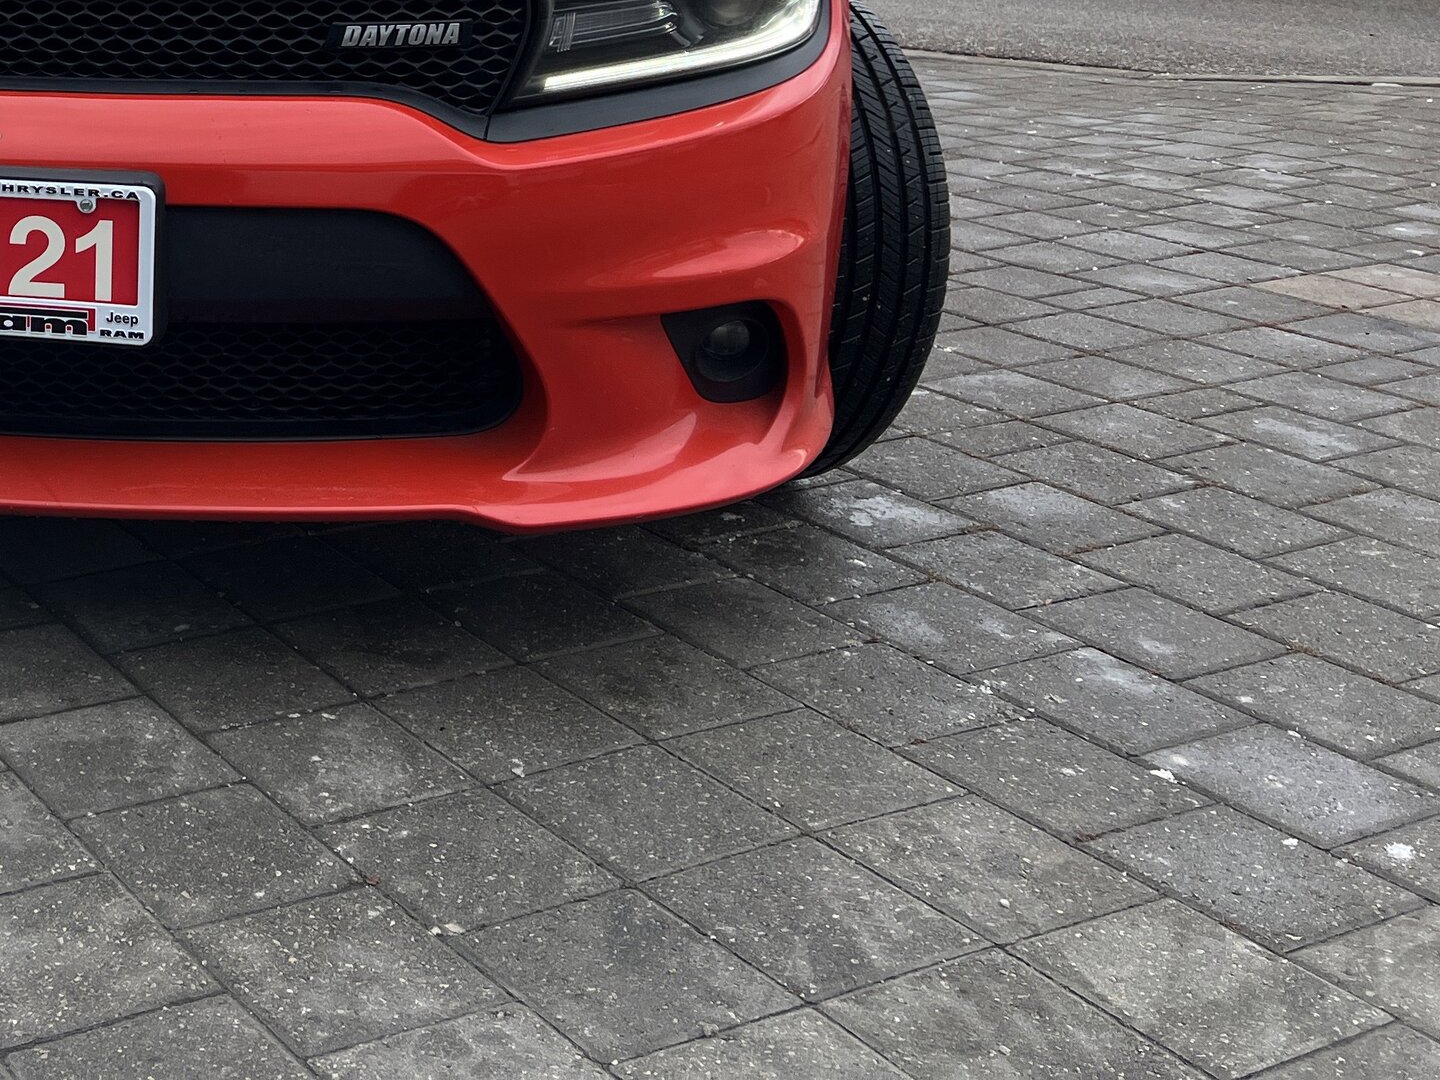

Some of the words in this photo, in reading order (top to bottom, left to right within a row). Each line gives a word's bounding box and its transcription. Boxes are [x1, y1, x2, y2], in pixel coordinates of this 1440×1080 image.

[341, 22, 460, 47] DAYTONA
[105, 311, 139, 328] Jeep
[100, 329, 145, 340] RAM
